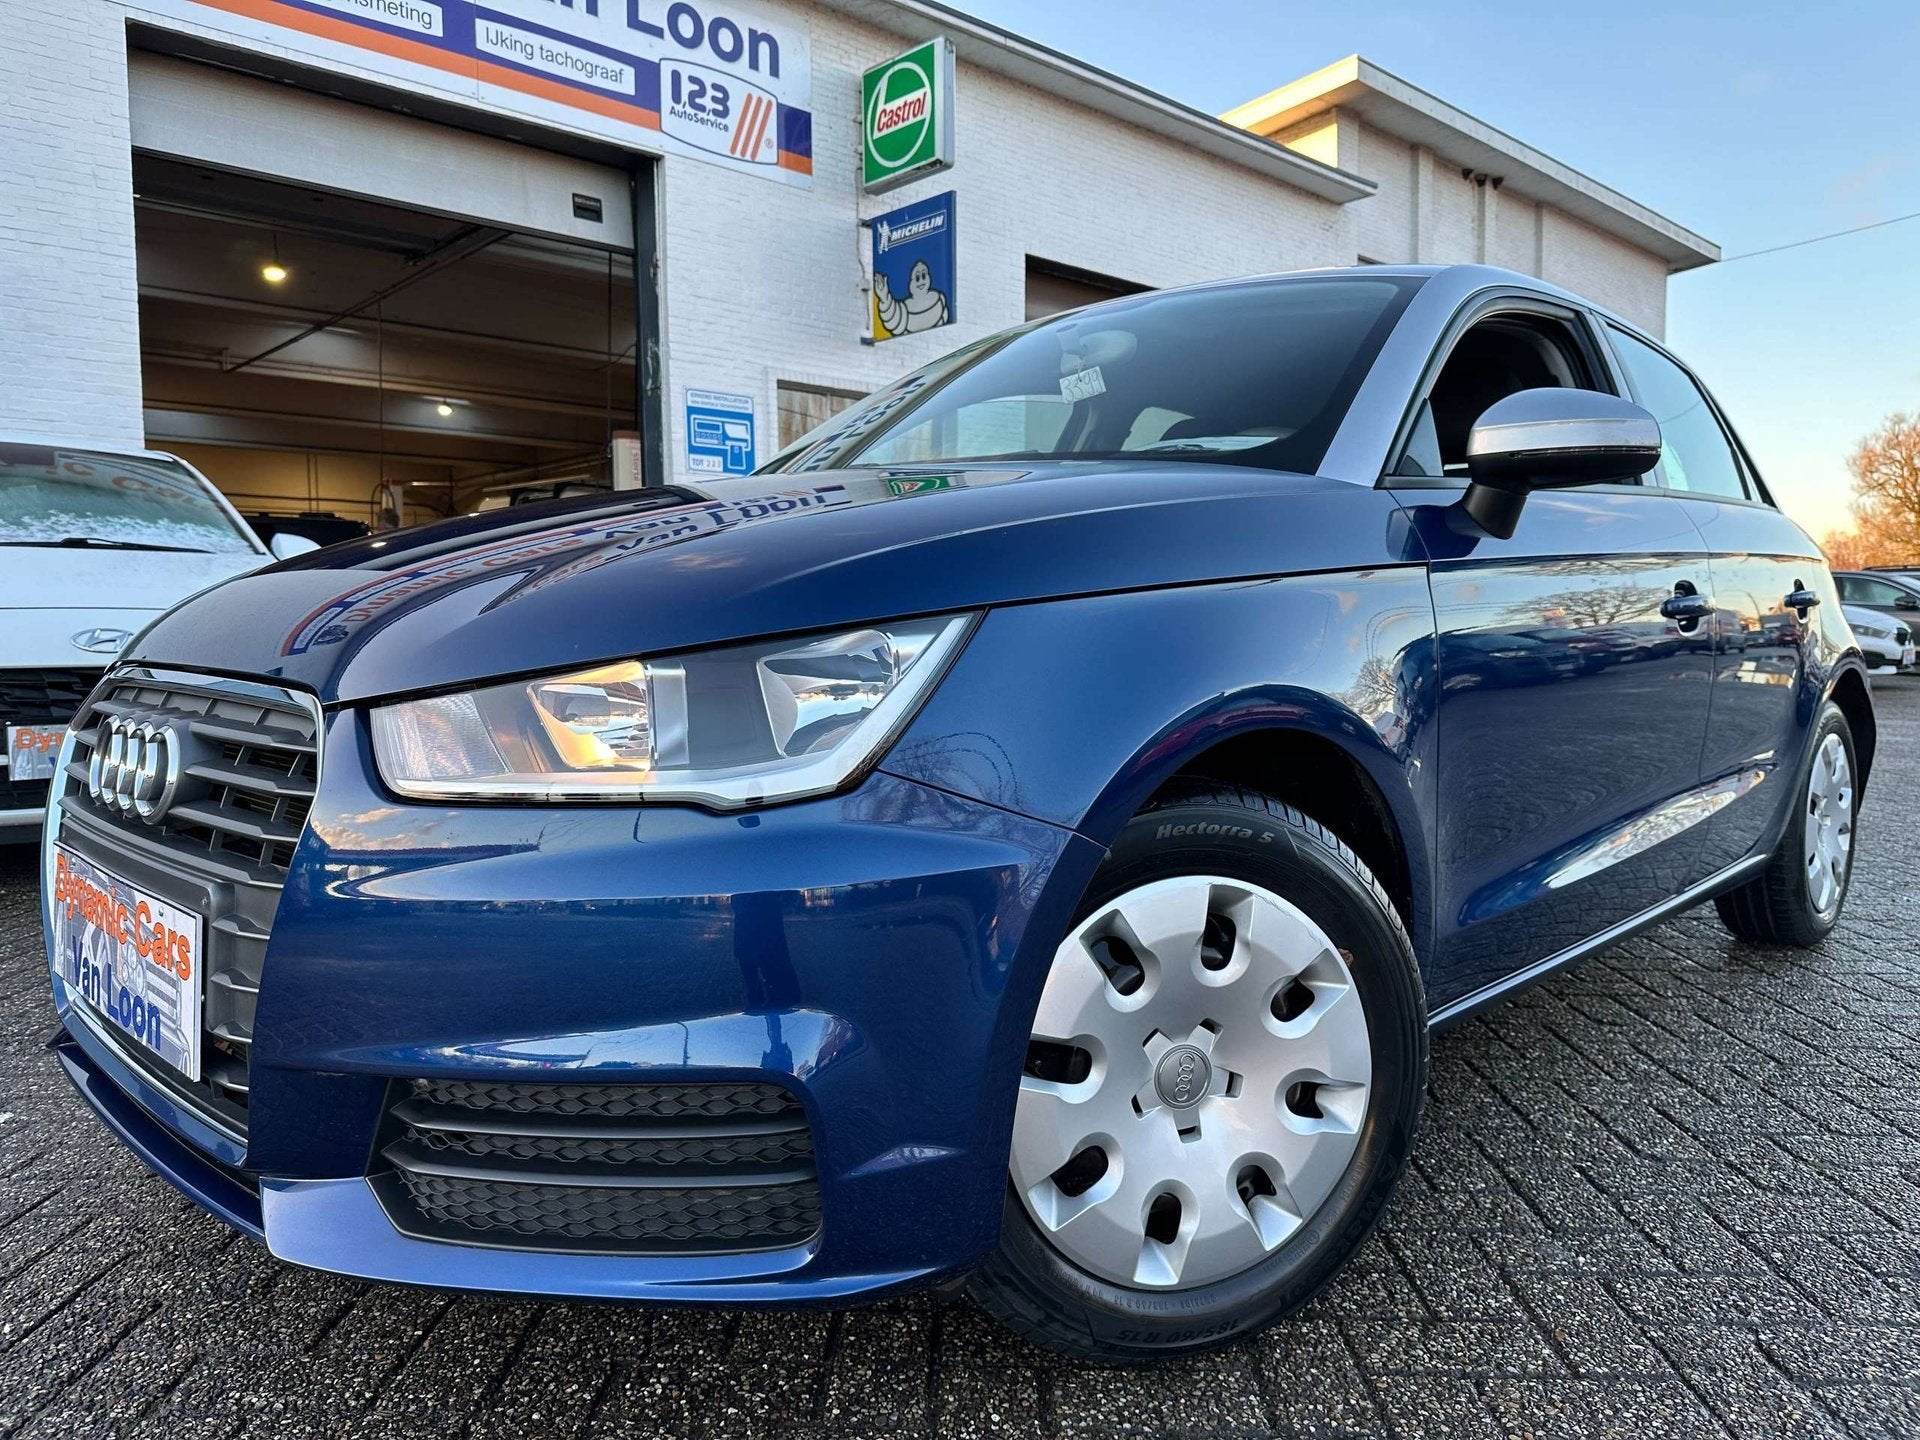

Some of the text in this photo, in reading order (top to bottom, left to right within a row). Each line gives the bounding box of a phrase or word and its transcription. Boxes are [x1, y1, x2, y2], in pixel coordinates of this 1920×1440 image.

[485, 26, 624, 84] IJking tachograaf
[669, 105, 729, 133] AutoService
[876, 91, 928, 134] Castrol
[890, 214, 944, 242] MICHELIN
[1155, 821, 1275, 845] Hectorra 5
[56, 852, 191, 981] Dynamic Cars
[72, 935, 161, 1051] Van Loon
